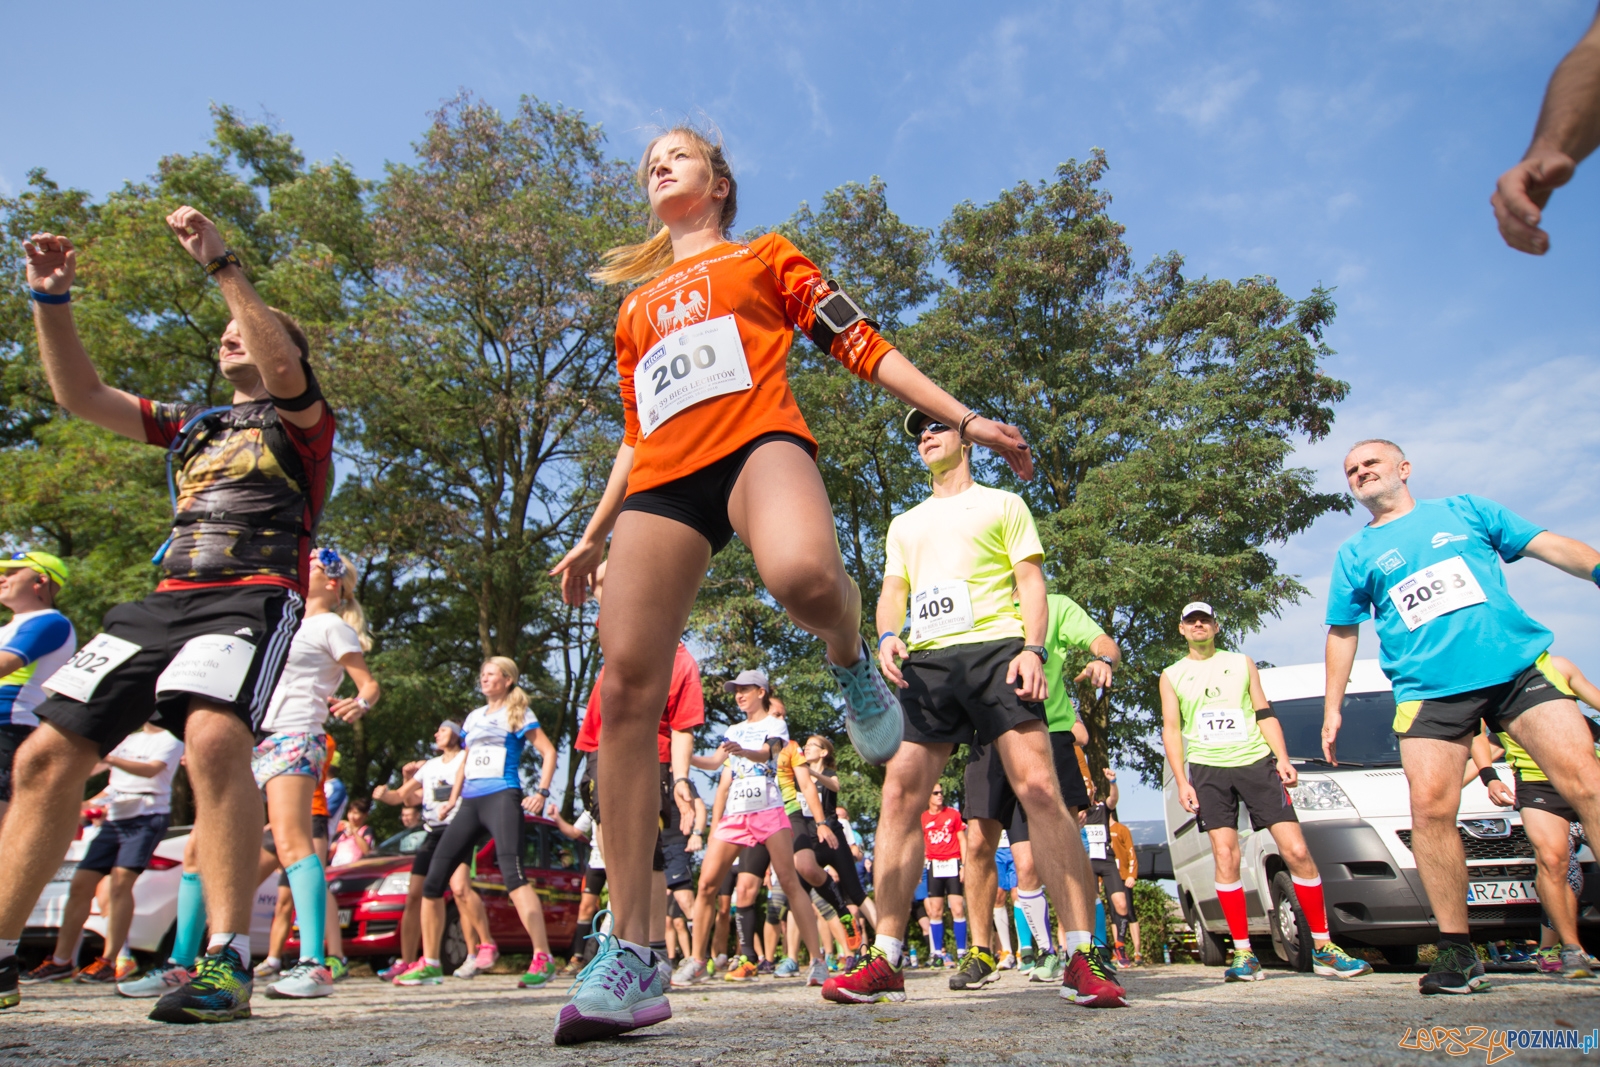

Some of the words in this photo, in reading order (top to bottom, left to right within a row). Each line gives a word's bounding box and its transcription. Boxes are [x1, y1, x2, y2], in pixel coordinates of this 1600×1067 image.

[652, 344, 716, 396] 200
[669, 385, 688, 400] BIEG
[690, 368, 736, 389] LECHITÓW
[919, 596, 954, 620] 409
[1206, 718, 1235, 730] 172
[475, 756, 490, 766] 60
[733, 787, 762, 800] 2403
[1473, 883, 1503, 900] RZ
